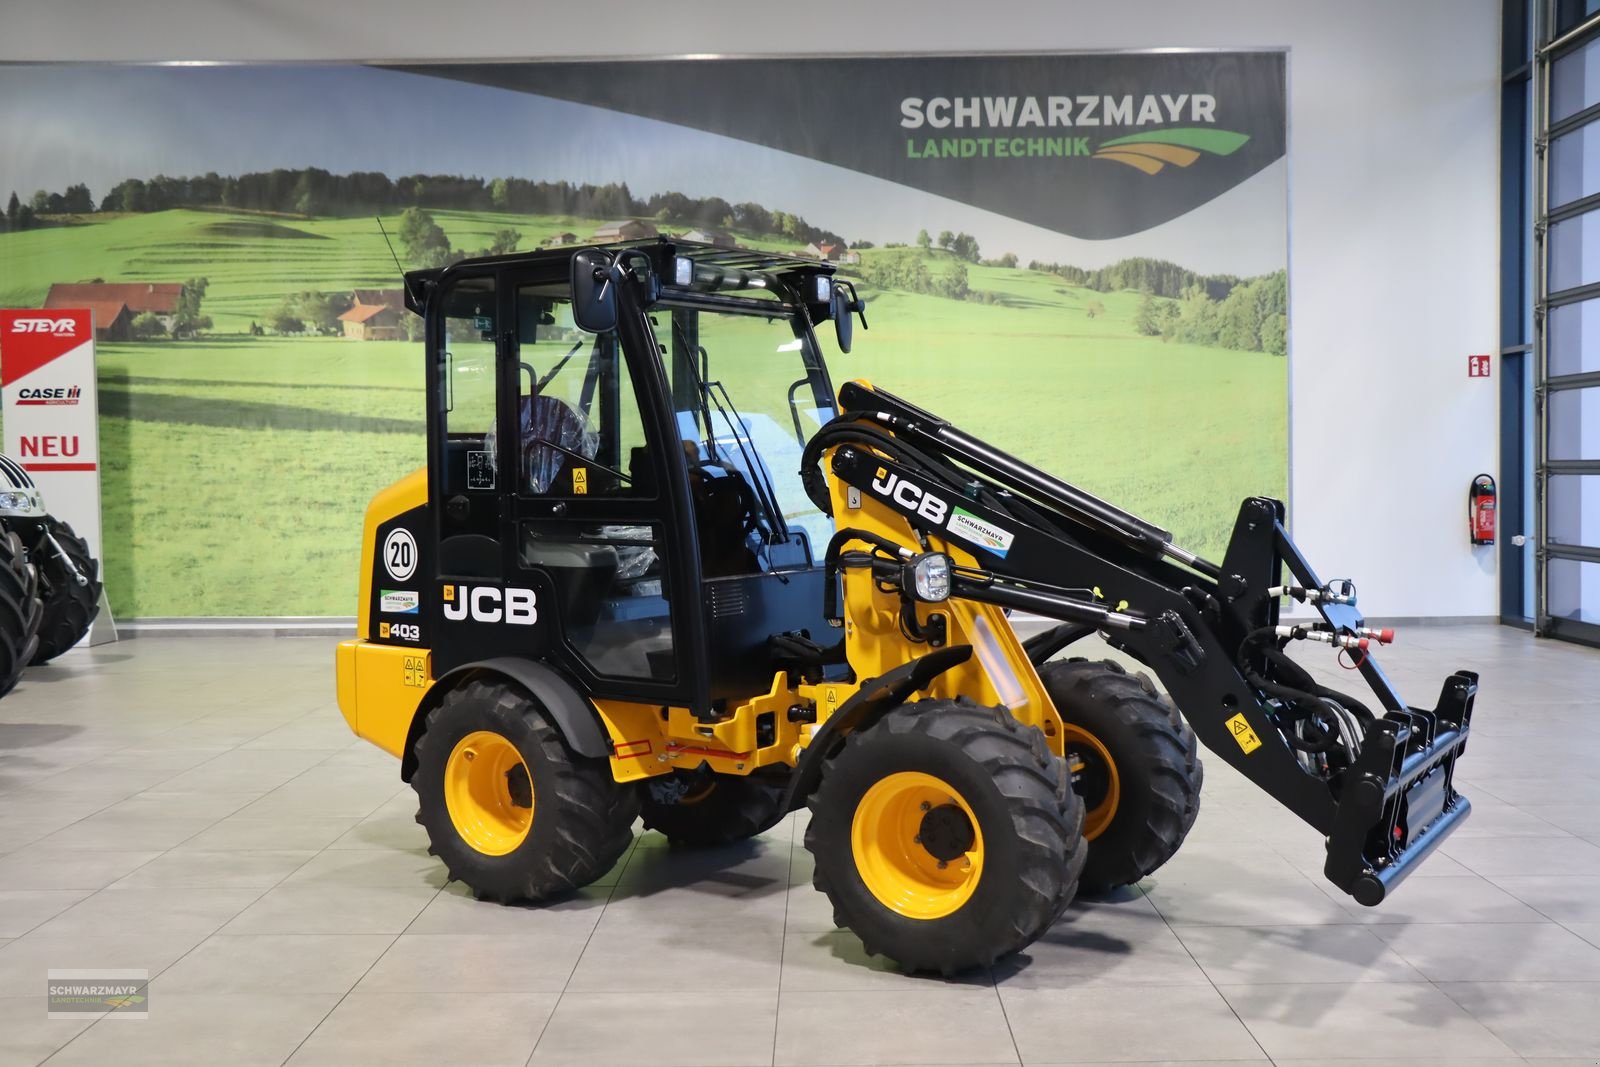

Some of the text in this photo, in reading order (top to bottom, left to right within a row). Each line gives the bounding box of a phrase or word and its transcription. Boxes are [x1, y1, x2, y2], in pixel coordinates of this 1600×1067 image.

[900, 94, 1217, 128] SCHWARZMAYR
[907, 136, 1091, 159] LANDTECHNIK
[12, 319, 76, 333] STEYR
[19, 388, 65, 399] CASE
[20, 435, 79, 457] NEU
[871, 473, 949, 526] JCB
[957, 515, 1004, 542] SCHWARZMAYR
[391, 541, 411, 568] 20
[443, 585, 538, 625] JCB
[390, 623, 420, 638] 403
